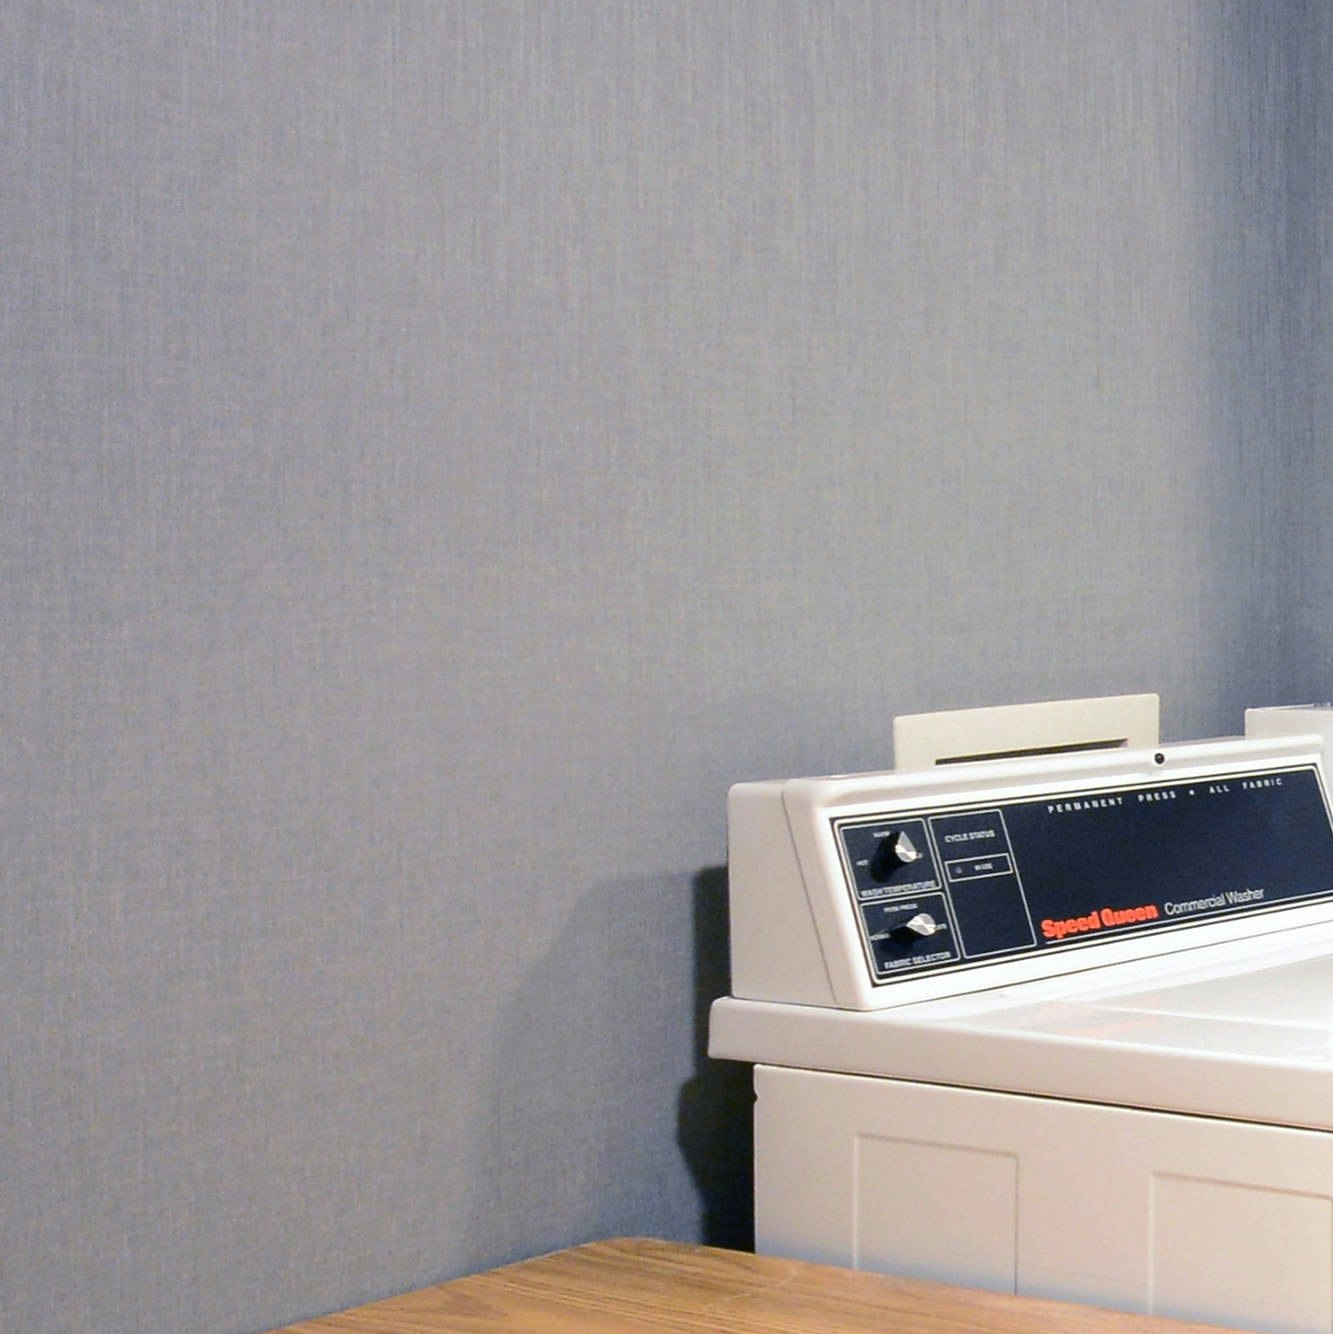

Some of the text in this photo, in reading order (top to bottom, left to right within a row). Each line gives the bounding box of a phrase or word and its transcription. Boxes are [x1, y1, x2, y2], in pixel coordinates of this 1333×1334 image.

[1047, 778, 1283, 814] PERMANENT PRESS ALL FABRIC
[944, 832, 969, 843] CYCLE
[1041, 887, 1265, 940] Speed Queen Commercial Washer
